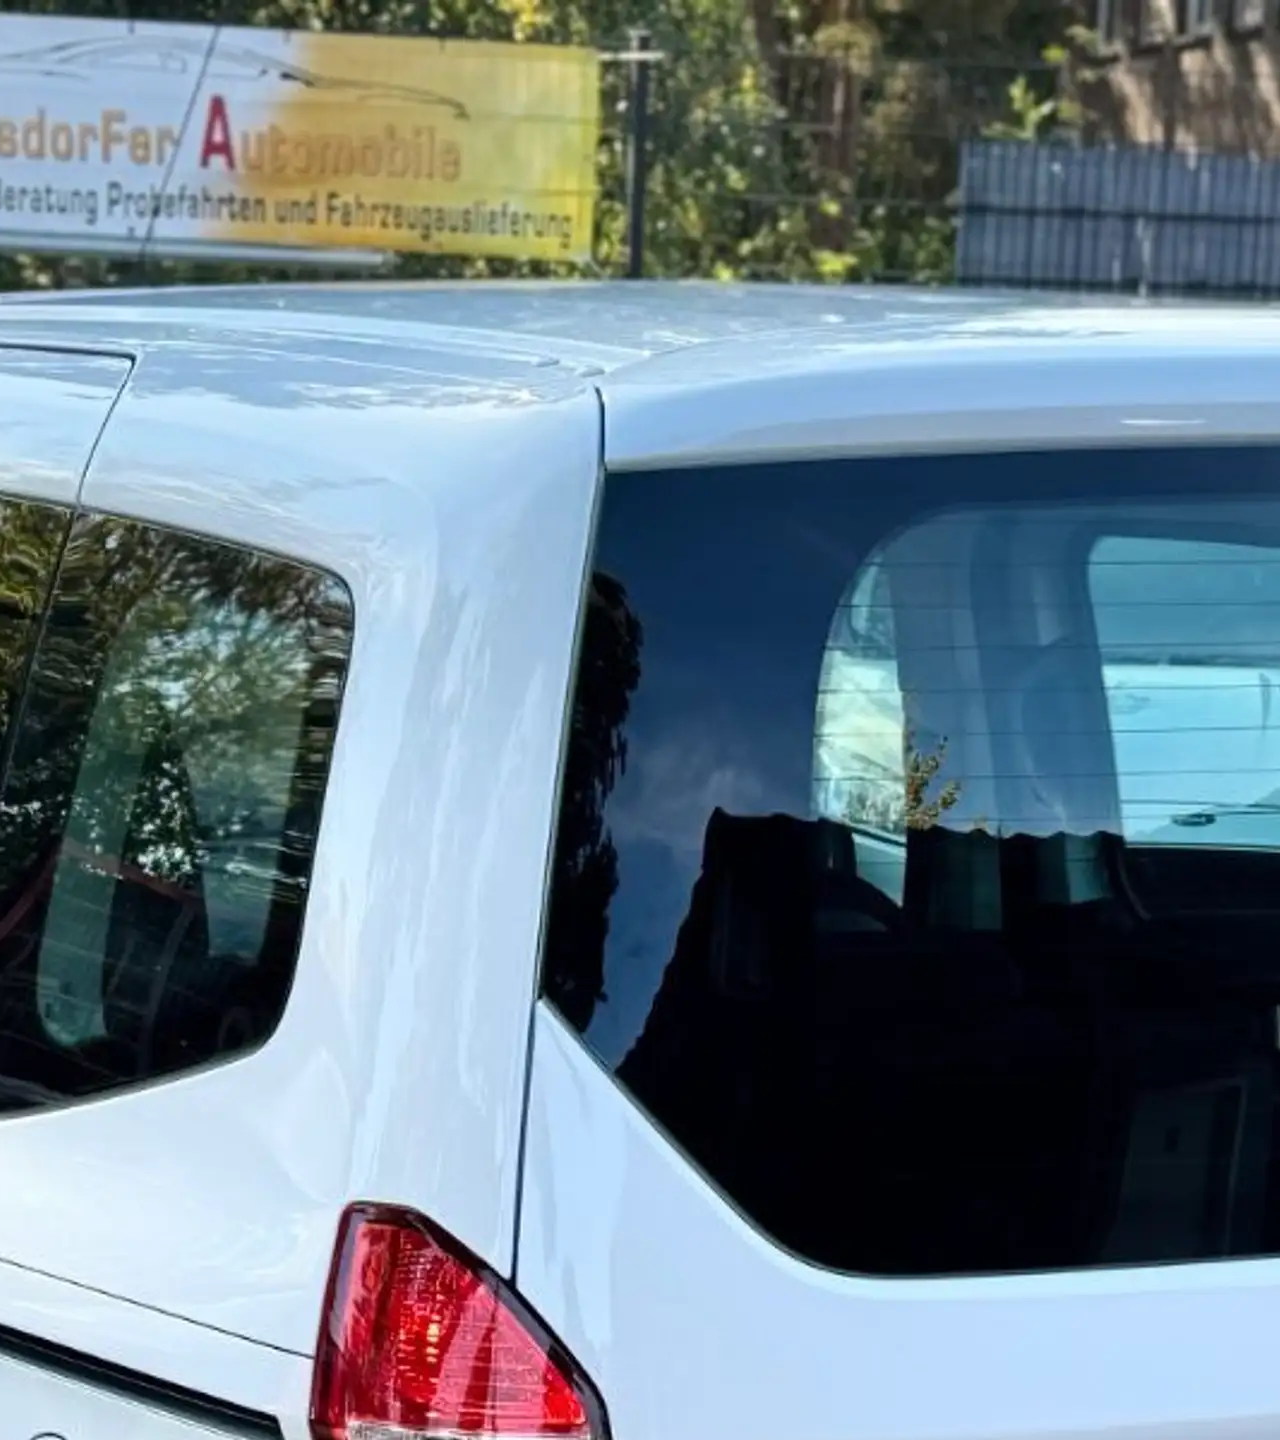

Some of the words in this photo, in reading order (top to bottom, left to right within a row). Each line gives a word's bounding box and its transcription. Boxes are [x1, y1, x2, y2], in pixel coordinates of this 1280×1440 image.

[200, 94, 463, 183] Automobile
[107, 181, 266, 224] Probefahrten
[275, 191, 317, 225] und
[325, 191, 573, 250] Fahrzeugauslieferung
